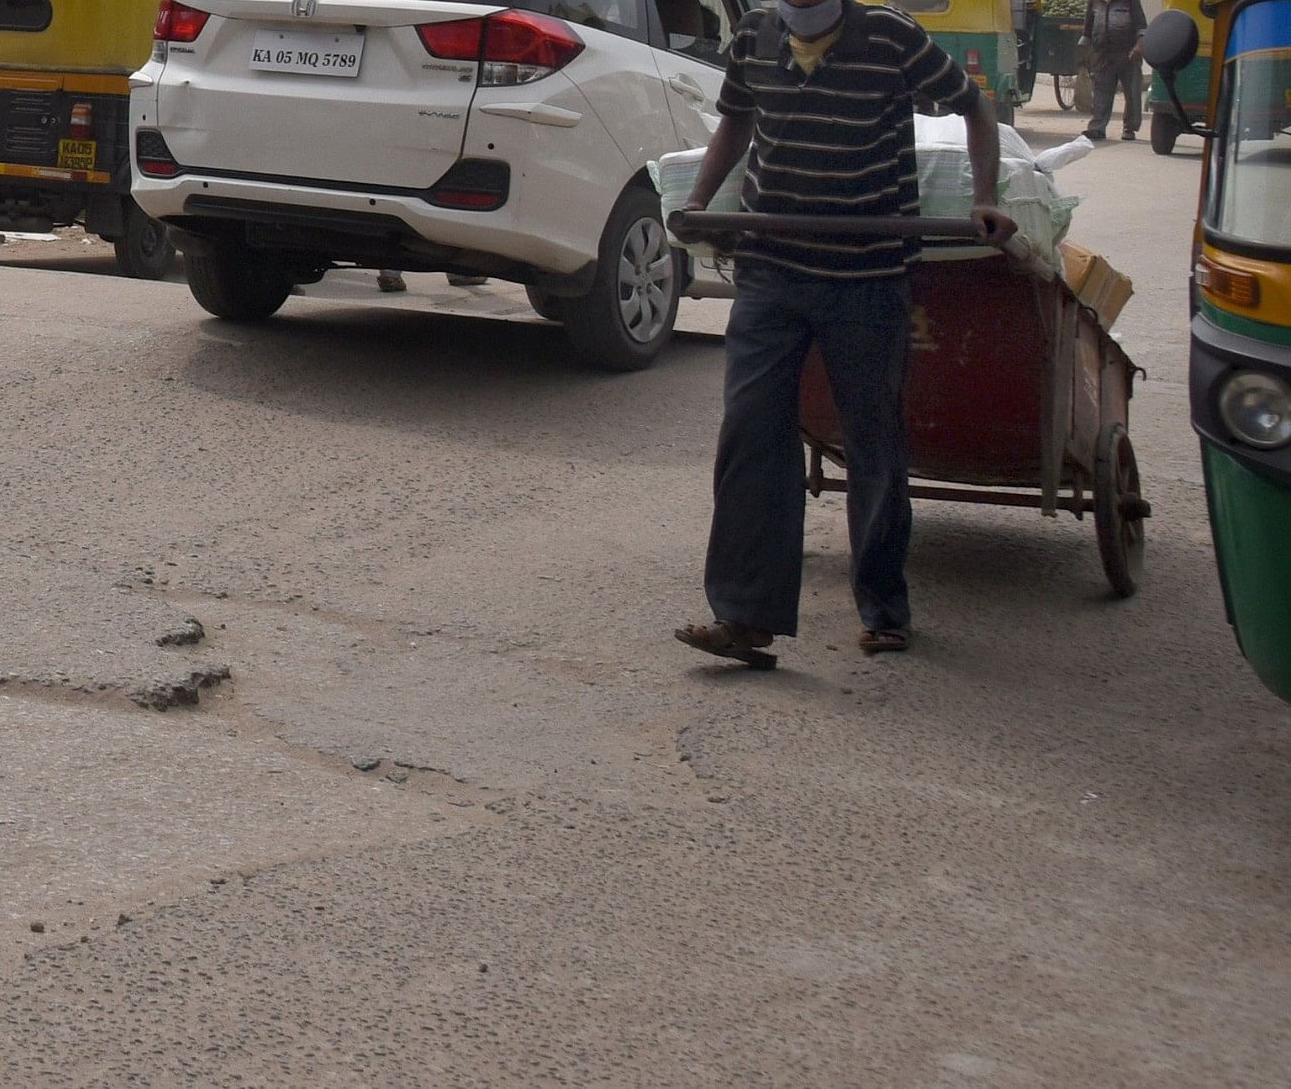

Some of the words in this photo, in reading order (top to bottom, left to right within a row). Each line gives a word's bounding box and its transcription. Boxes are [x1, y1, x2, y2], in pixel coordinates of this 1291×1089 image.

[252, 49, 271, 63] KA
[276, 51, 292, 64] 05
[296, 52, 319, 68] MQ
[322, 54, 356, 68] 5789
